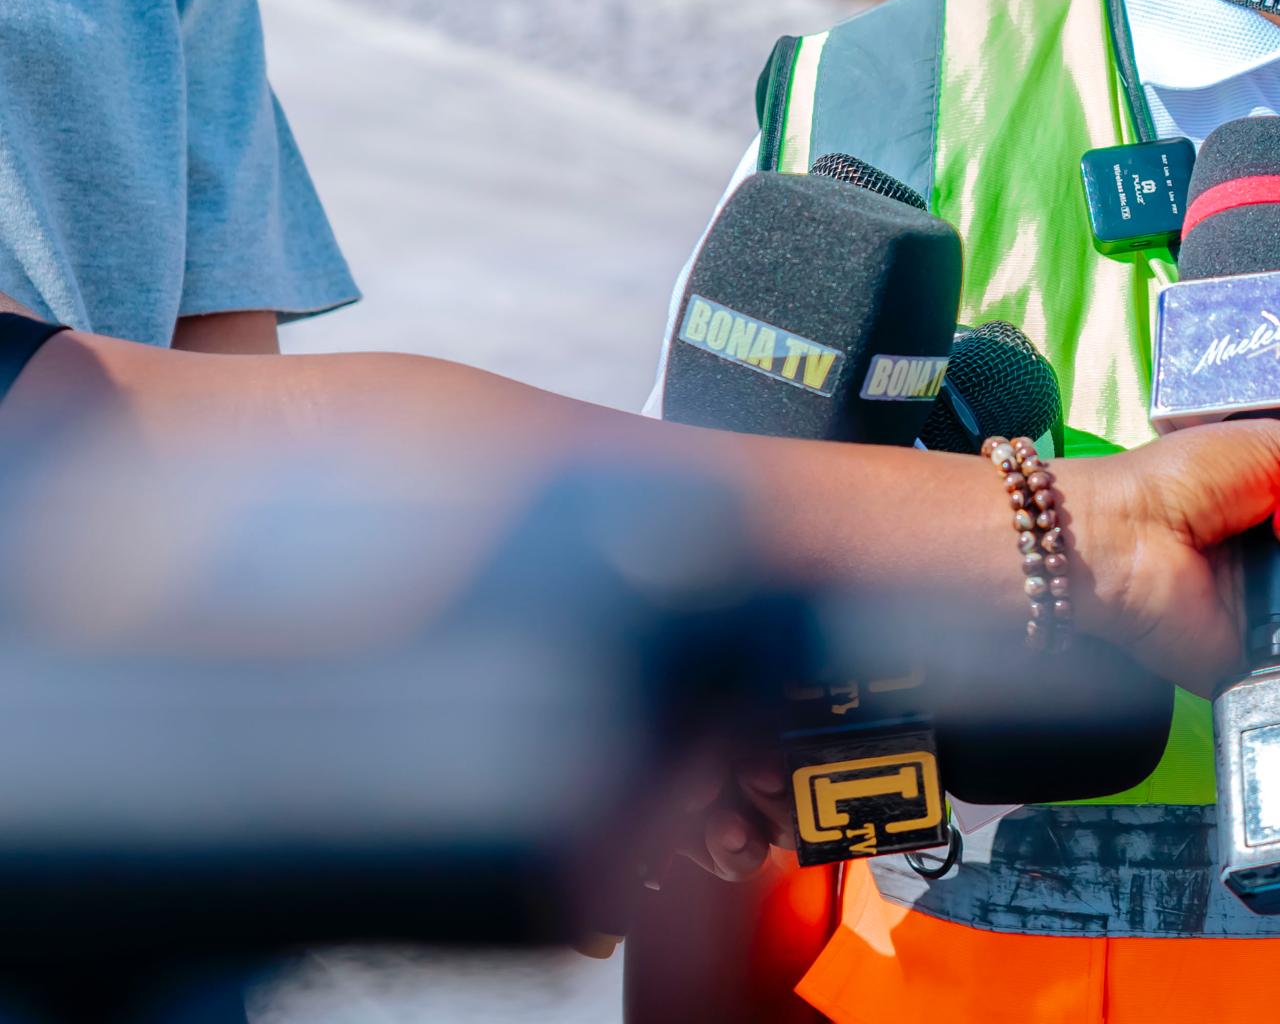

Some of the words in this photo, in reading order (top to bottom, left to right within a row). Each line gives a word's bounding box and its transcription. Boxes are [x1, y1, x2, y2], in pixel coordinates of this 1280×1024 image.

[684, 299, 776, 371] BONA
[781, 337, 836, 390] TV
[867, 358, 934, 397] BONA
[846, 823, 878, 855] TV
